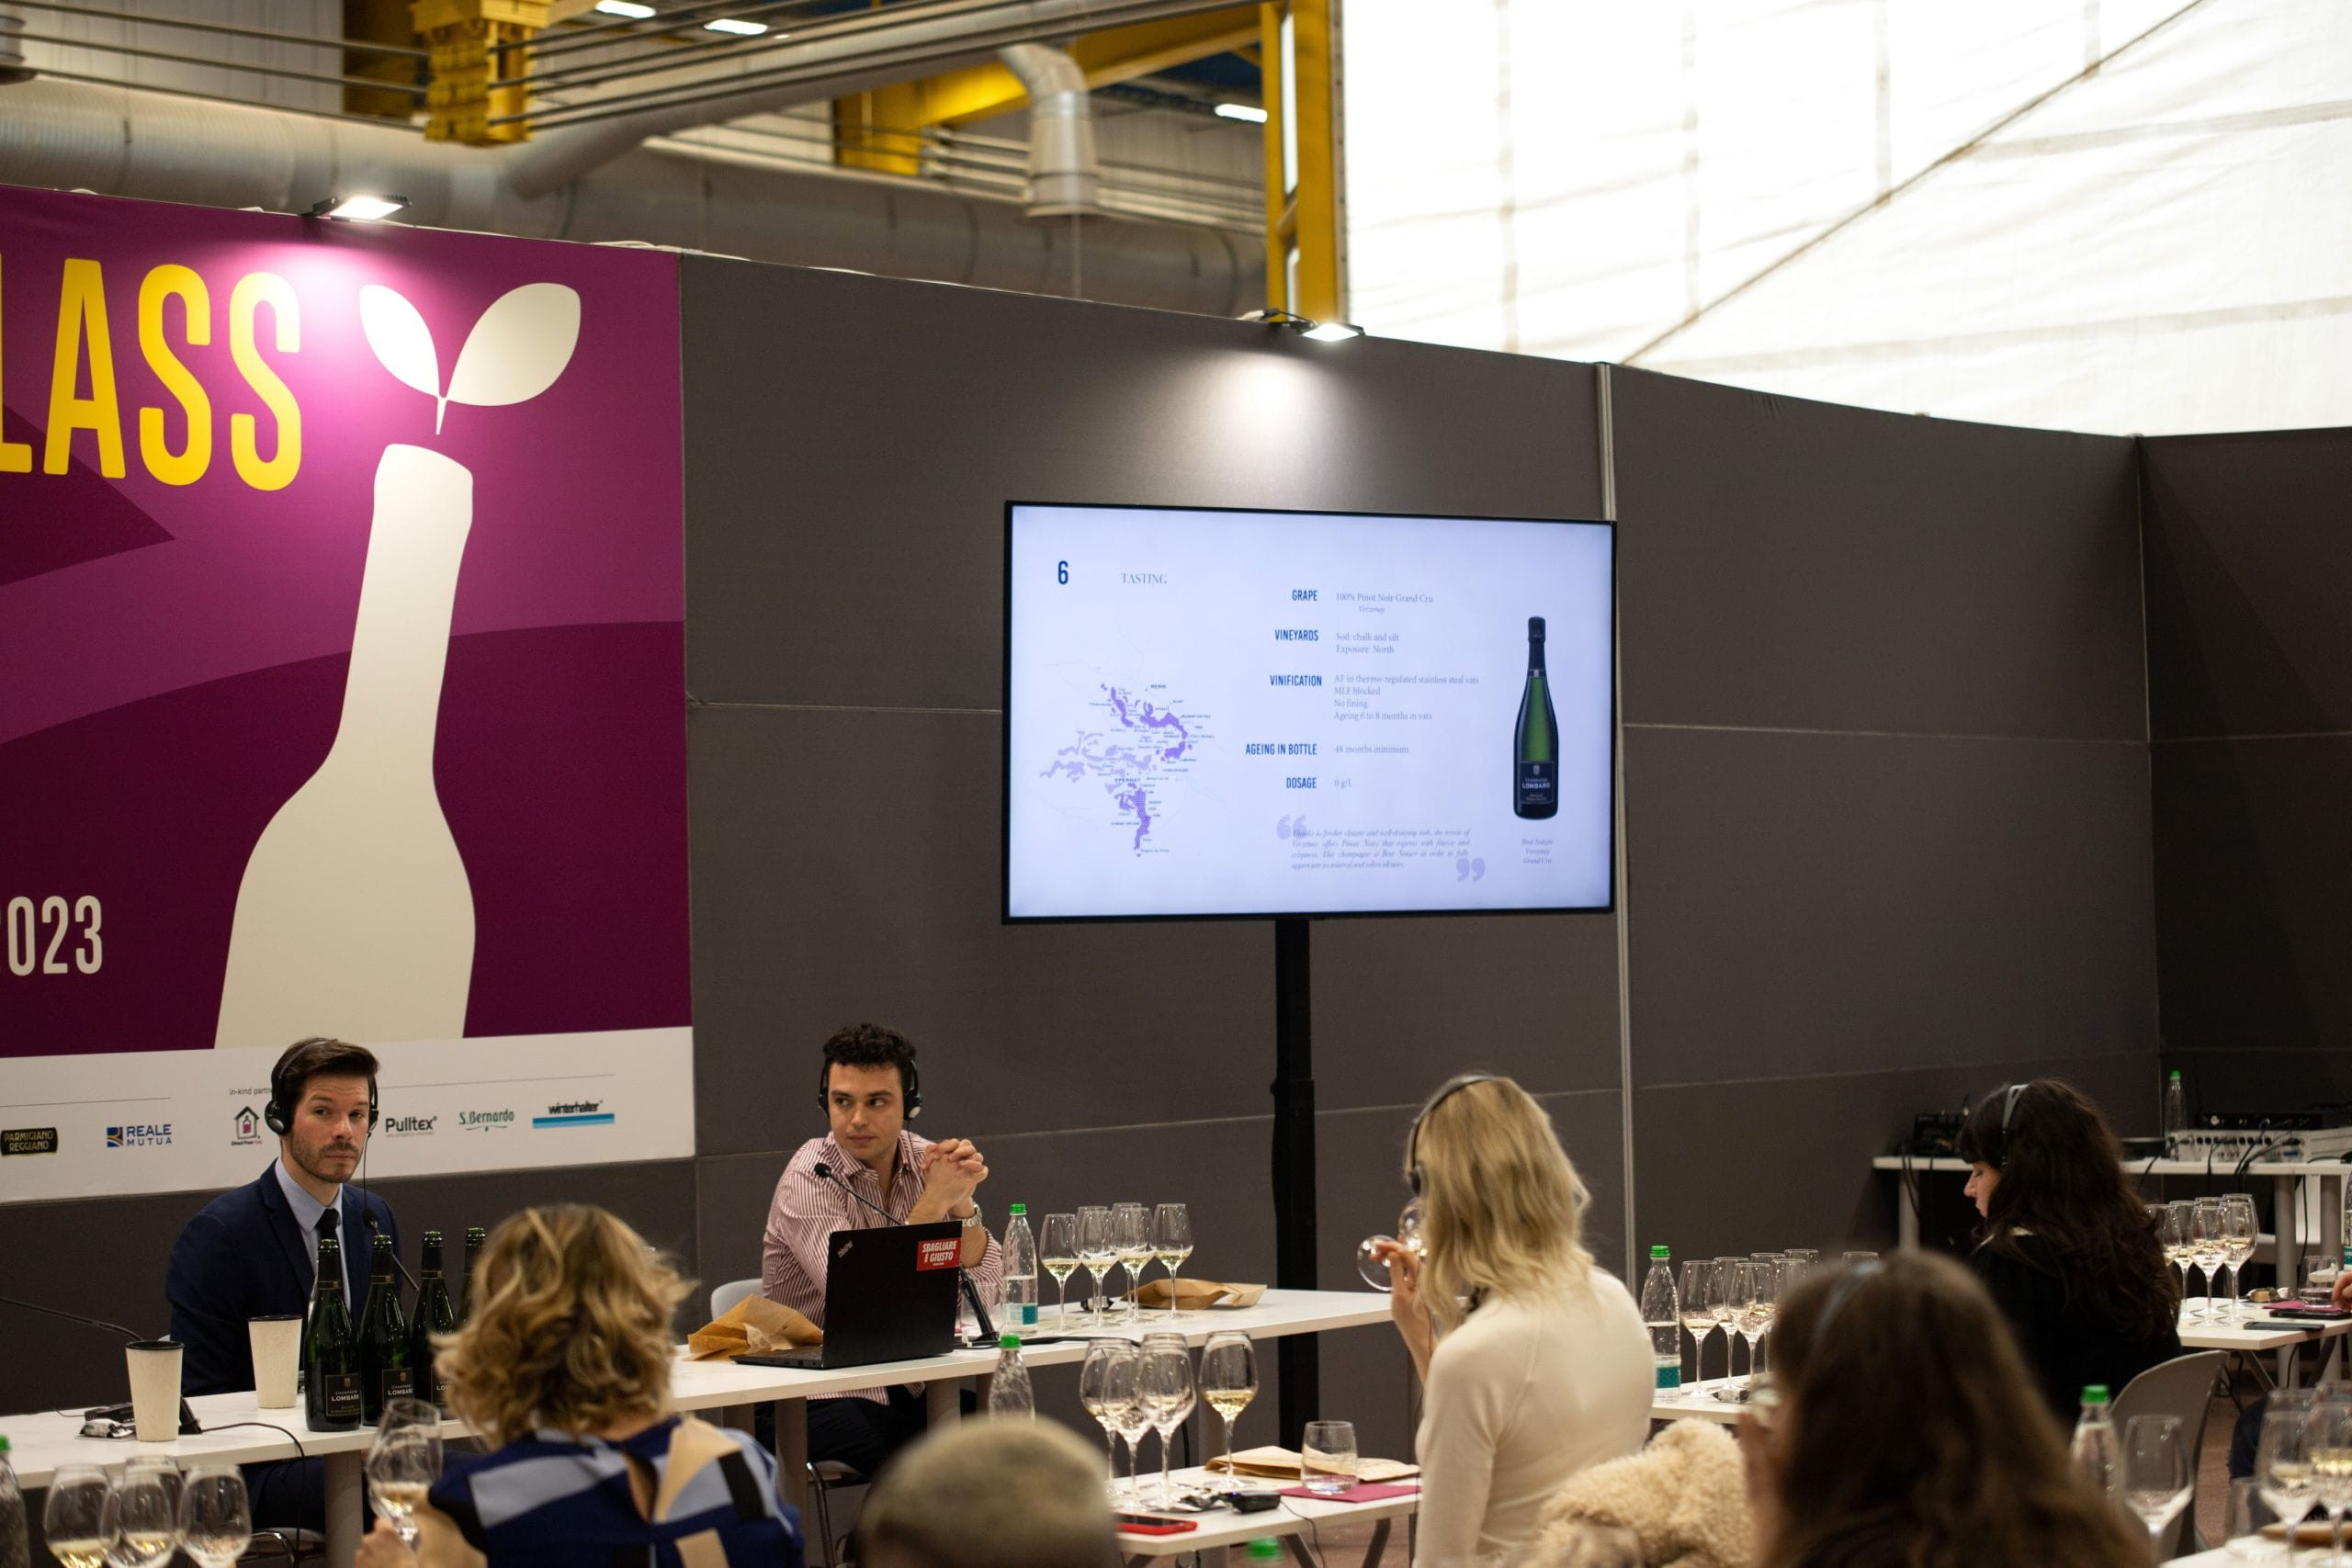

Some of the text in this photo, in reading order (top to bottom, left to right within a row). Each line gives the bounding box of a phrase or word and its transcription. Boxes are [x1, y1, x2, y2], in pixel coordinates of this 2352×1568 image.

[1058, 560, 1069, 585] 6
[1121, 572, 1167, 585] TASTING
[1292, 590, 1318, 601] GRAPE
[1336, 593, 1433, 603] 100% Pinot Noir Grand Cru
[1275, 629, 1319, 641] VINEYARDS
[1353, 633, 1373, 642] chalk
[1374, 633, 1387, 642] and
[1389, 633, 1399, 642] silt
[1373, 645, 1394, 654] North
[1270, 675, 1322, 687] VINIFICATION
[1334, 675, 1345, 684] AF
[1347, 675, 1354, 684] in
[1356, 675, 1417, 684] thermo-regulated
[1418, 675, 1447, 684] stainless
[1465, 675, 1479, 684] vats
[1353, 687, 1380, 695] blocked
[1334, 699, 1368, 708] No fining
[1334, 712, 1359, 721] Ageing
[1360, 712, 1365, 721] 6
[1367, 712, 1374, 721] to
[1381, 712, 1408, 721] months
[1409, 712, 1417, 721] in
[1418, 712, 1432, 721] vats
[1245, 744, 1317, 755] AGEING IN BOTTLE
[1335, 745, 1409, 753] 48 months minimum
[1286, 777, 1317, 789] DOSAGE
[0, 895, 103, 976] 023
[229, 1088, 252, 1096] in-kind
[548, 1101, 599, 1114] winterhalter
[4, 1130, 54, 1142] PARMIGIANO
[127, 1124, 172, 1137] REALE
[10, 1141, 49, 1152] REGGIANO
[127, 1138, 172, 1146] MUTUA
[922, 1241, 957, 1252] SBAGLIARE
[930, 1252, 954, 1262] GIUSTO
